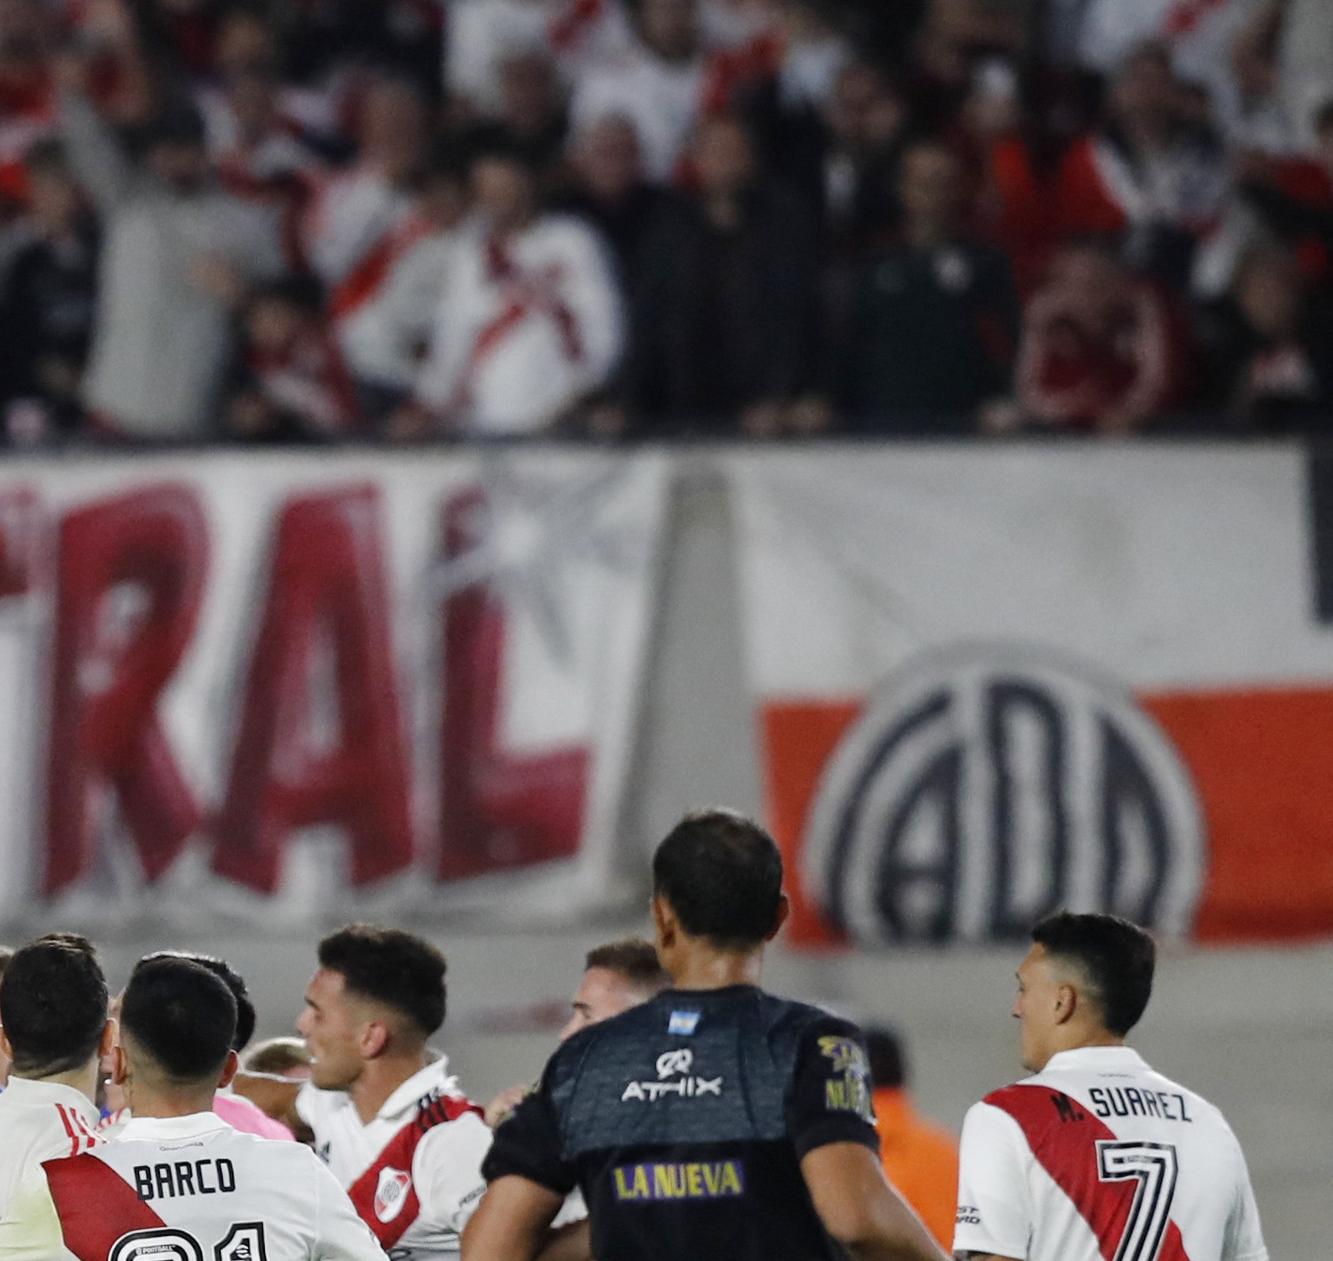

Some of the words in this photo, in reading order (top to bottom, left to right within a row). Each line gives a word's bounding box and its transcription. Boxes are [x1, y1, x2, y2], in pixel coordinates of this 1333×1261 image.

[621, 1076, 723, 1102] ATHIX
[1089, 1087, 1192, 1123] SUAREZ
[133, 1158, 236, 1201] BARCO
[613, 1164, 651, 1199] LA
[653, 1161, 742, 1198] NUEVA
